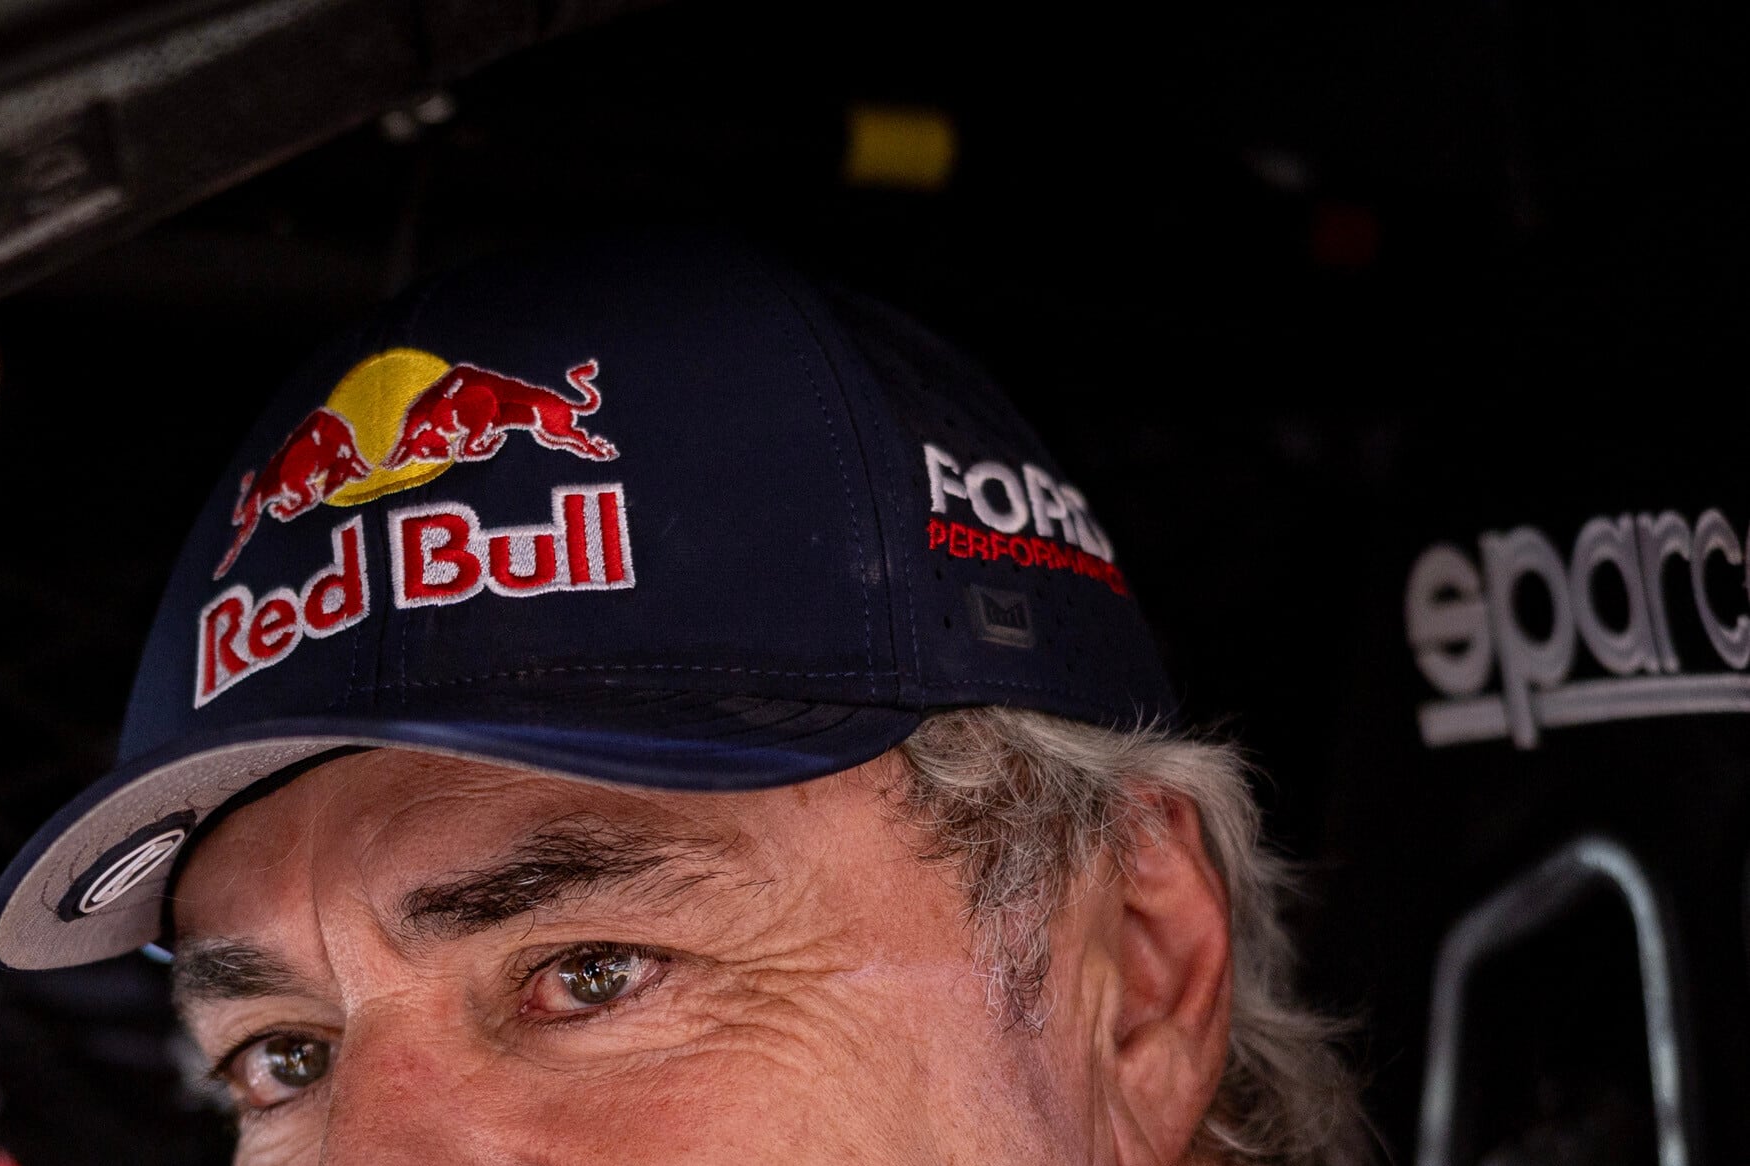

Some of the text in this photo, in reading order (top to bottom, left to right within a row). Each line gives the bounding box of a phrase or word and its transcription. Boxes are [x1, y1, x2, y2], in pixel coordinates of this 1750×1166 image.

[194, 482, 636, 709] Red Bull
[1404, 507, 1750, 749] sparc
